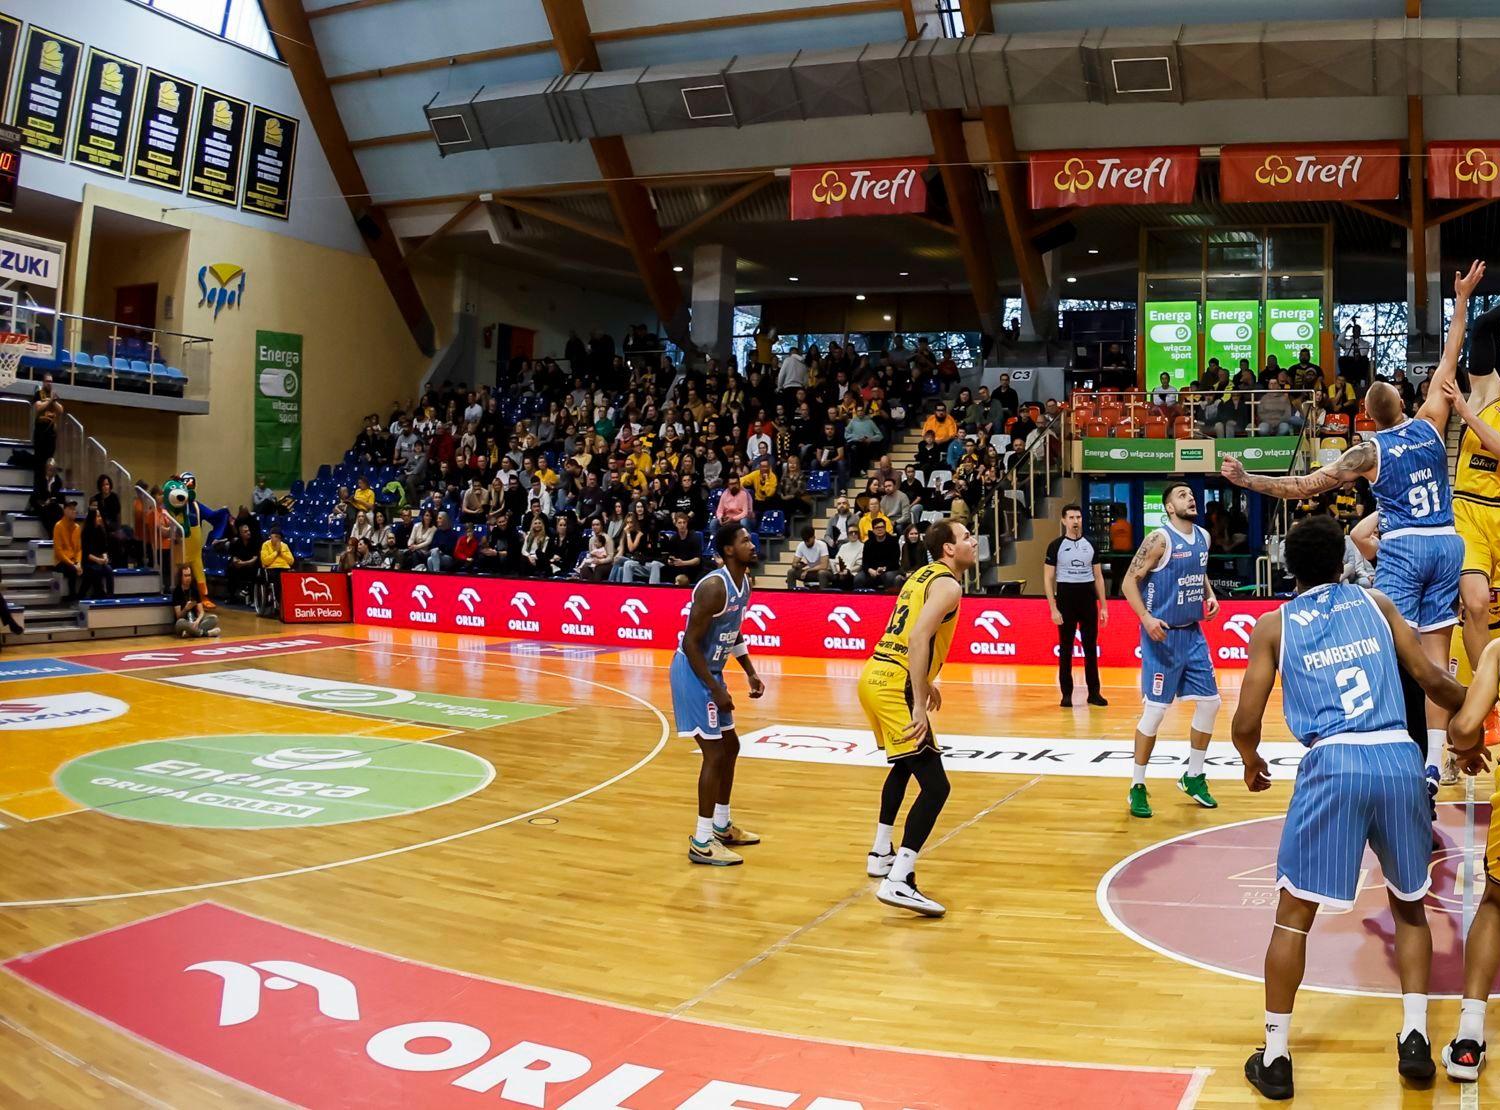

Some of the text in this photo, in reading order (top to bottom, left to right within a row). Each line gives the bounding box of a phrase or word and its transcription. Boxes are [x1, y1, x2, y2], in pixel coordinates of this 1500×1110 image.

[1096, 156, 1172, 195] Trefl
[1293, 155, 1363, 190] Trefl
[849, 169, 916, 205] Trefl
[198, 265, 246, 323] Sopot
[1150, 310, 1192, 323] Energa
[1210, 309, 1253, 322] Energa
[1270, 308, 1314, 321] Energa
[1163, 344, 1192, 353] włącza
[1223, 343, 1252, 352] włącza
[260, 346, 299, 367] Energa
[1170, 352, 1192, 360] sport
[1231, 351, 1252, 360] sport
[1292, 350, 1314, 359] spt
[1012, 370, 1031, 380] C3
[272, 401, 298, 412] włącza
[279, 412, 298, 425] sport
[1085, 449, 1109, 459] Energa
[1130, 450, 1155, 459] włącza
[1155, 451, 1174, 460] sport
[1409, 467, 1433, 485] WYKA
[1407, 481, 1441, 518] 91
[1143, 501, 1166, 512] Energ
[295, 607, 343, 619] Bank Pekao
[366, 607, 392, 619] ORLEN
[409, 611, 437, 623] ORLEN
[455, 614, 485, 627] ORLEN
[508, 619, 540, 632] ORLEN
[561, 623, 595, 636] ORLEN
[617, 627, 653, 640] ORLEN
[190, 638, 323, 656] ORLEN
[743, 634, 781, 648] ORLEN
[824, 636, 866, 650] ORLEN
[970, 642, 1016, 656] ORLEN
[1218, 646, 1249, 660] ORL
[1303, 637, 1381, 672] PEMBERTON
[1335, 666, 1375, 720] 2
[133, 758, 370, 799] Energa
[90, 776, 316, 817] GRUPA ORLEN
